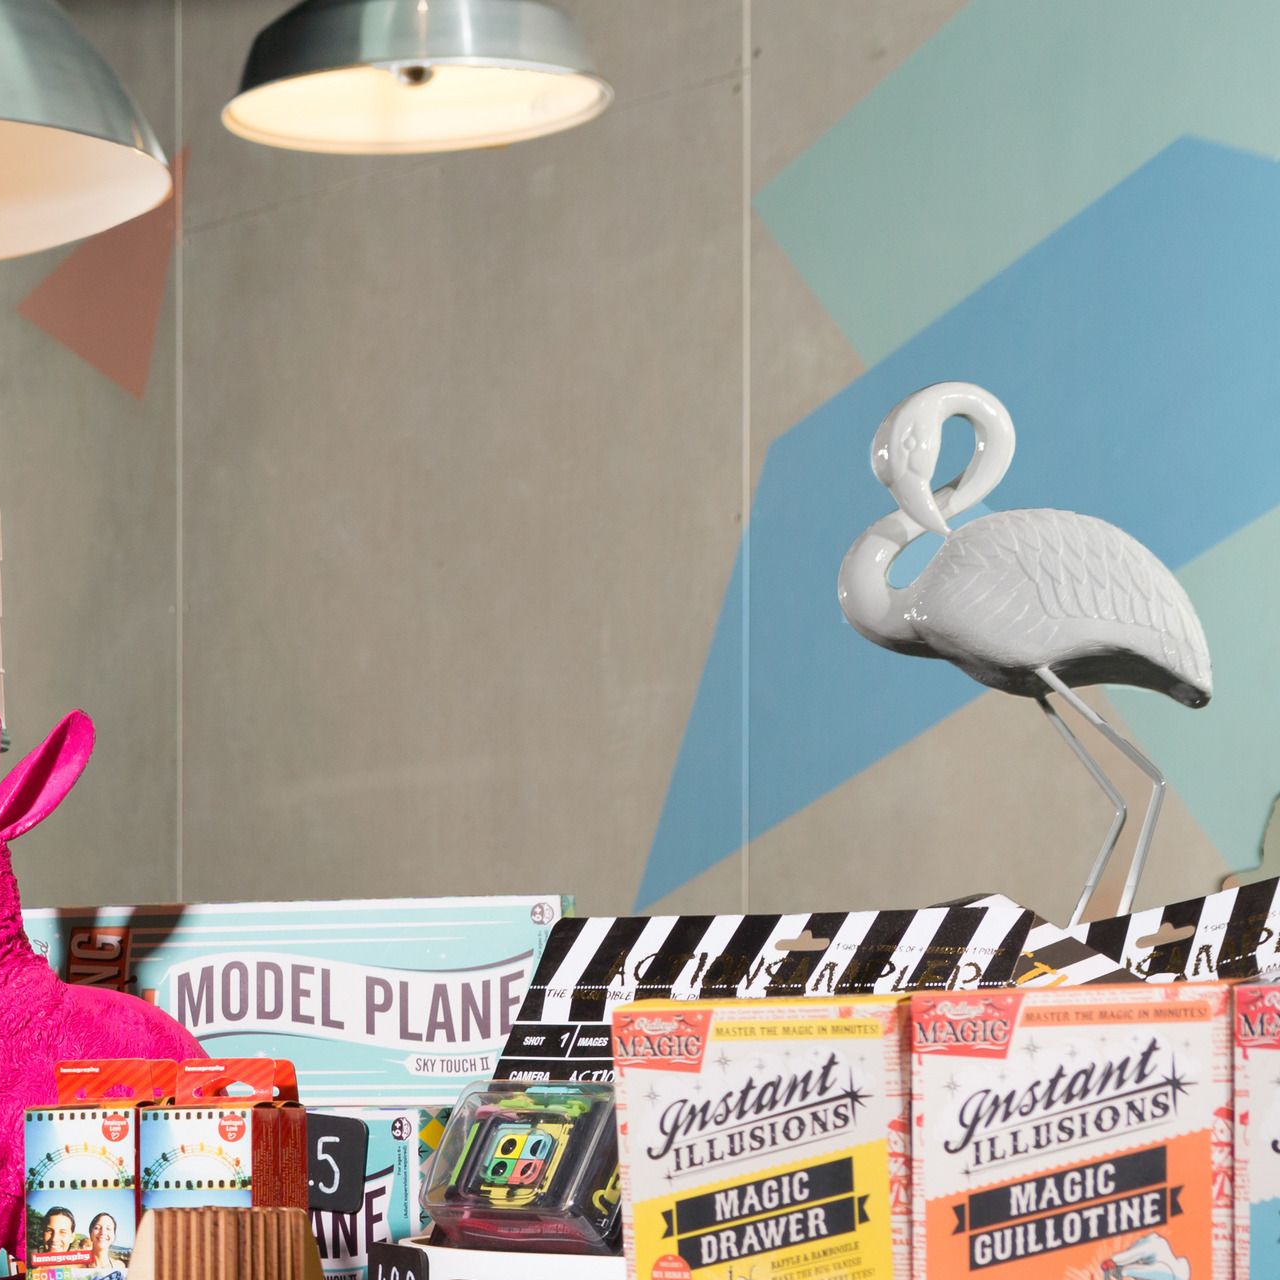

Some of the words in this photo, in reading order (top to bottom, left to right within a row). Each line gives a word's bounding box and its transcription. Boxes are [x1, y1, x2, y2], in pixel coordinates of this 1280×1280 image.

[177, 960, 344, 1031] MODEL
[365, 969, 526, 1042] PLANE
[546, 988, 568, 999] THE
[716, 1026, 756, 1037] MASTER
[760, 1026, 778, 1036] THE
[782, 1026, 814, 1036] MAGIC
[817, 1025, 828, 1034] IN
[832, 1024, 879, 1034] MINUTES!
[914, 1018, 1010, 1044] MAGIC
[1025, 1010, 1070, 1022] MASTER
[1074, 1009, 1093, 1021] THE
[1097, 1008, 1133, 1020] MAGIC
[1137, 1008, 1150, 1019] IN
[1154, 1006, 1208, 1020] MINUTES!
[522, 1036, 546, 1046] SHOT
[560, 1032, 570, 1048] 1
[577, 1037, 608, 1047] IMAGES
[614, 1034, 702, 1060] MAGIC
[415, 1058, 436, 1074] SKY
[440, 1056, 476, 1074] TOUCH
[509, 1071, 550, 1081] CAMERA
[647, 1052, 838, 1160] Instant
[944, 1037, 1160, 1154] Instant
[674, 1102, 851, 1172] ILLUSIONS
[972, 1091, 1170, 1167] ILLUSIONS
[714, 1170, 810, 1223] MAGIC
[1010, 1162, 1116, 1218] MAGIC
[700, 1206, 828, 1266] DRAWER
[973, 1192, 1162, 1266] GUILLOTINE
